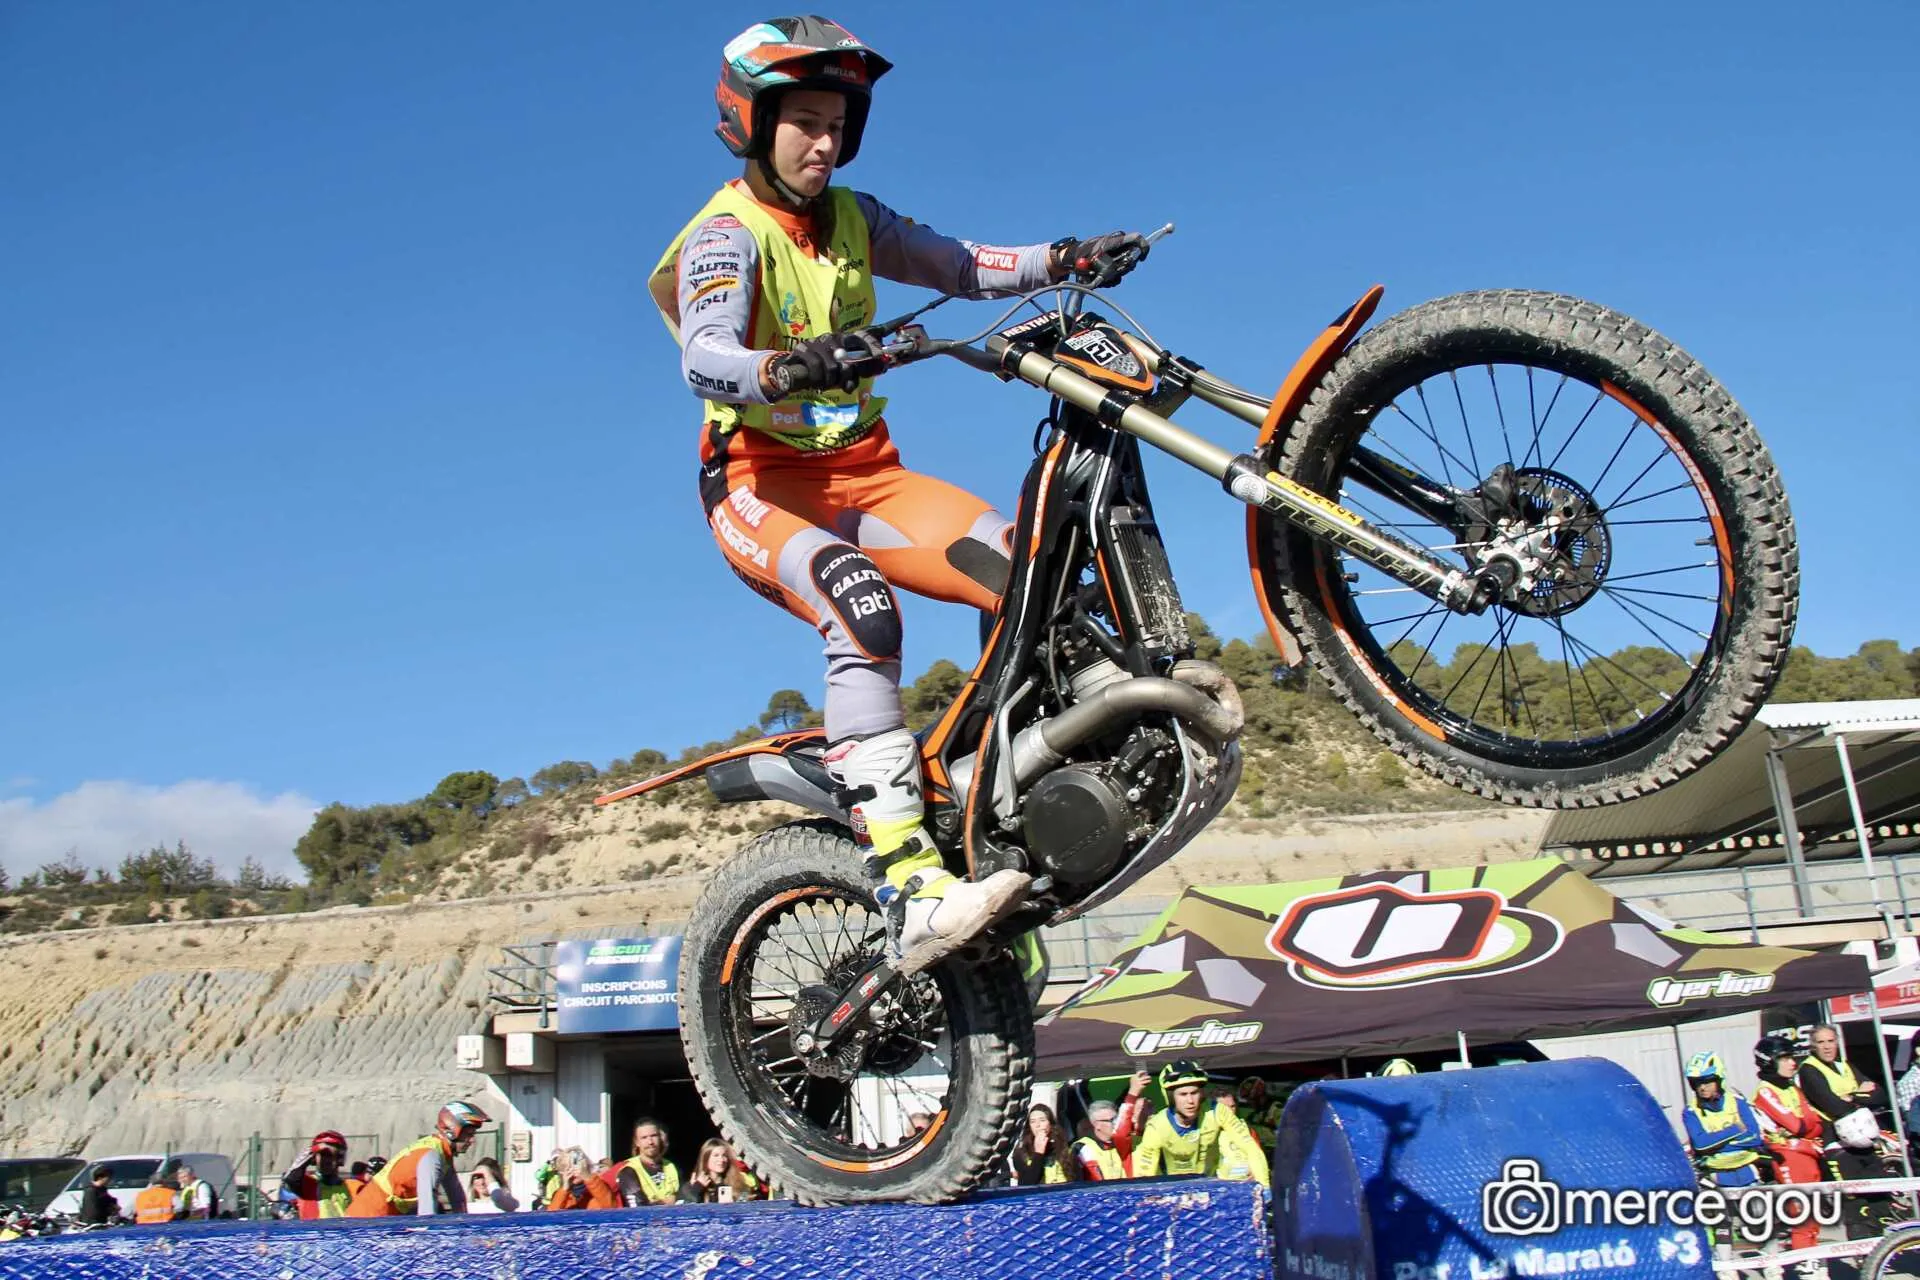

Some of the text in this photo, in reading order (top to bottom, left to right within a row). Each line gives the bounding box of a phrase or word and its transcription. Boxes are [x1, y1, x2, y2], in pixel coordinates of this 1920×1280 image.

[688, 369, 740, 394] COMAS
[729, 485, 771, 528] MOTUL
[849, 588, 892, 620] iati
[581, 980, 667, 993] INSCRIPCIONS
[563, 996, 613, 1007] CIRCUIT
[1513, 1240, 1636, 1276] Marató
